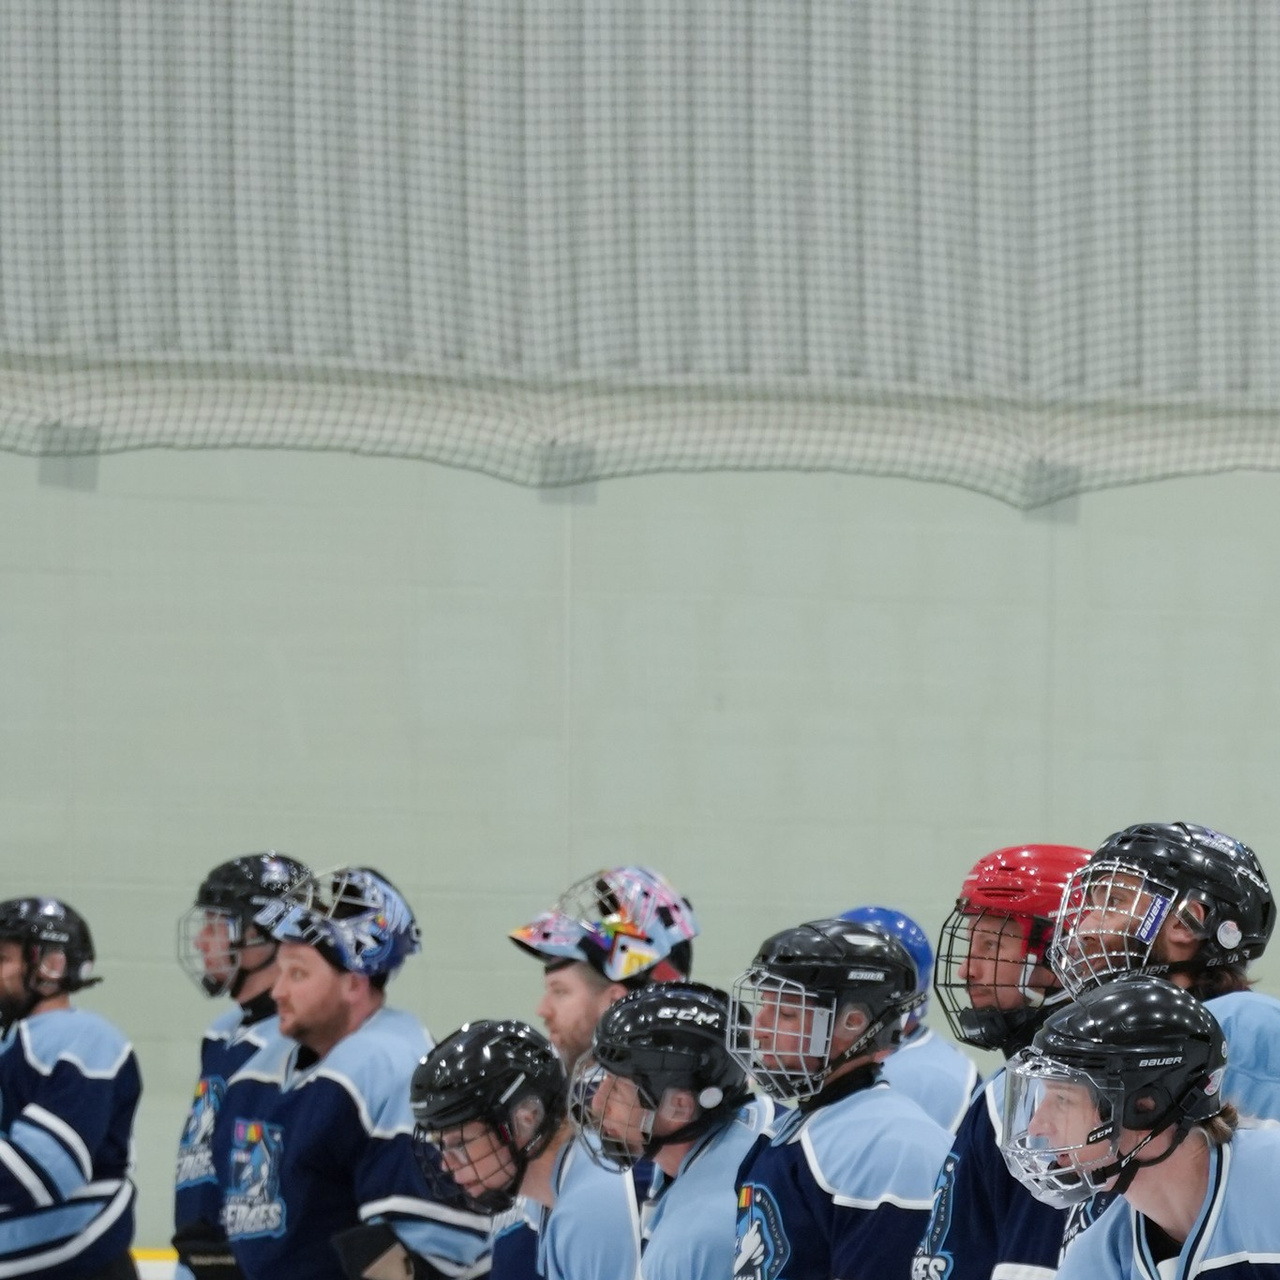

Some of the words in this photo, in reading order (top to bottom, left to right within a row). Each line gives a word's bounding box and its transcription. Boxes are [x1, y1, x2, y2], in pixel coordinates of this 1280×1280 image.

[1139, 898, 1164, 938] BAUER
[656, 1006, 720, 1028] CCM
[844, 1021, 884, 1059] ITECH
[1139, 1056, 1183, 1068] BAUER
[1088, 1127, 1114, 1143] CCM
